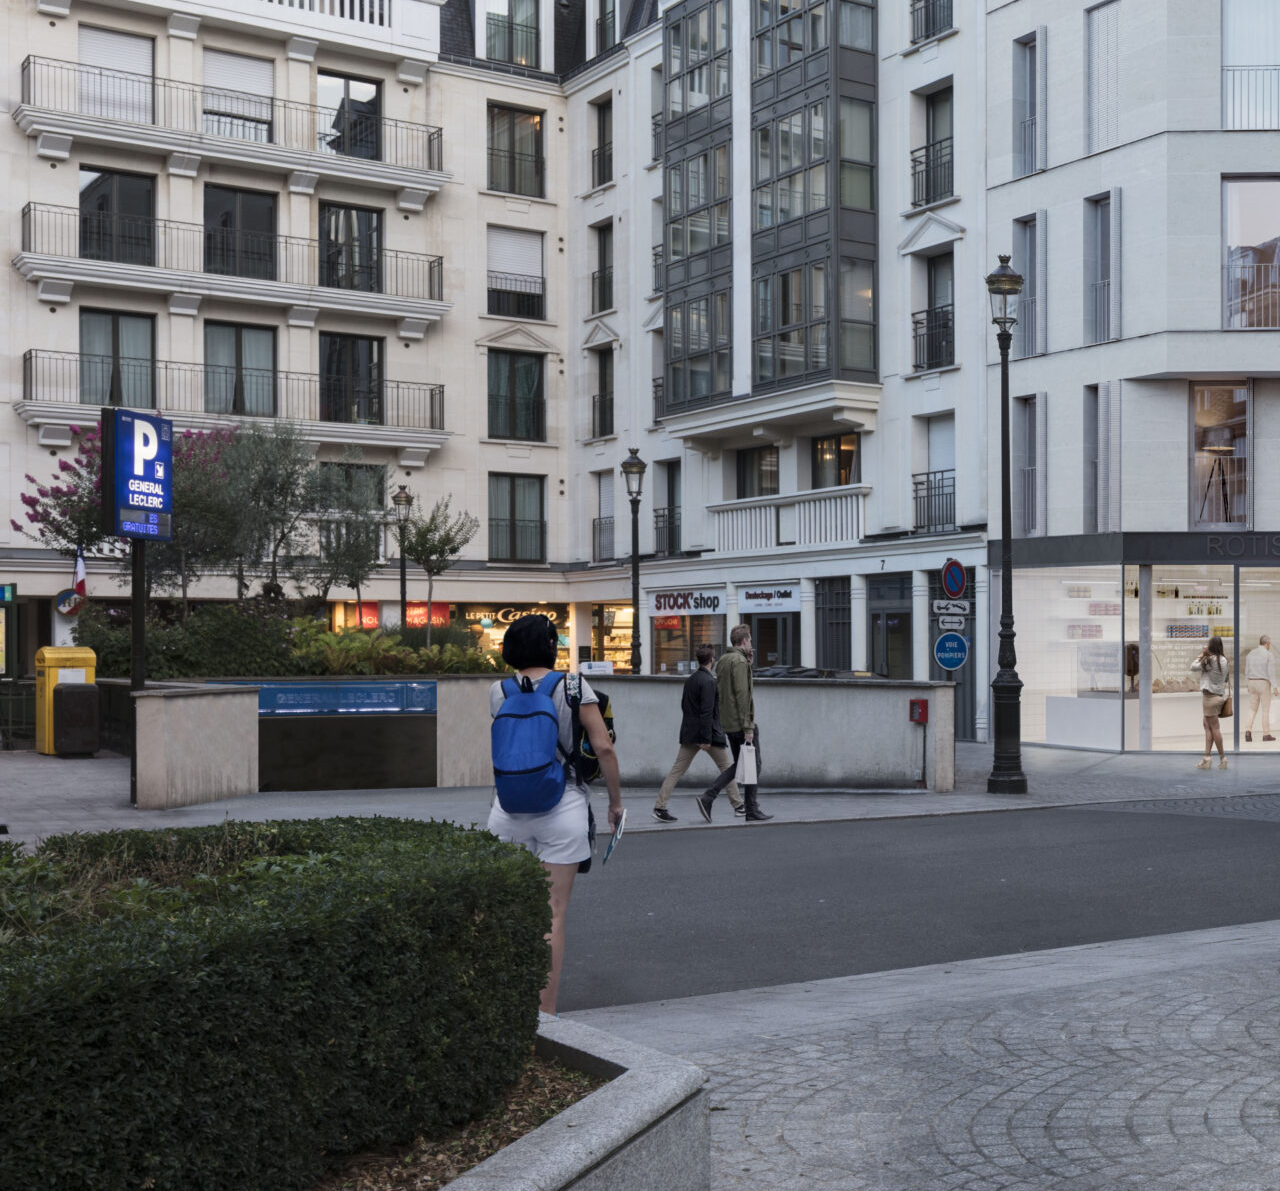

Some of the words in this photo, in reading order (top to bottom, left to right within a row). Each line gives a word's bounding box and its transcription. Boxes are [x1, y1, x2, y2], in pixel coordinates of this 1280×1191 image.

[134, 419, 158, 476] P
[129, 479, 164, 496] GENERAL
[129, 494, 163, 509] LECLERC
[122, 521, 158, 535] GRATUITES
[881, 559, 885, 570] 7
[406, 616, 445, 624] MAGSIN
